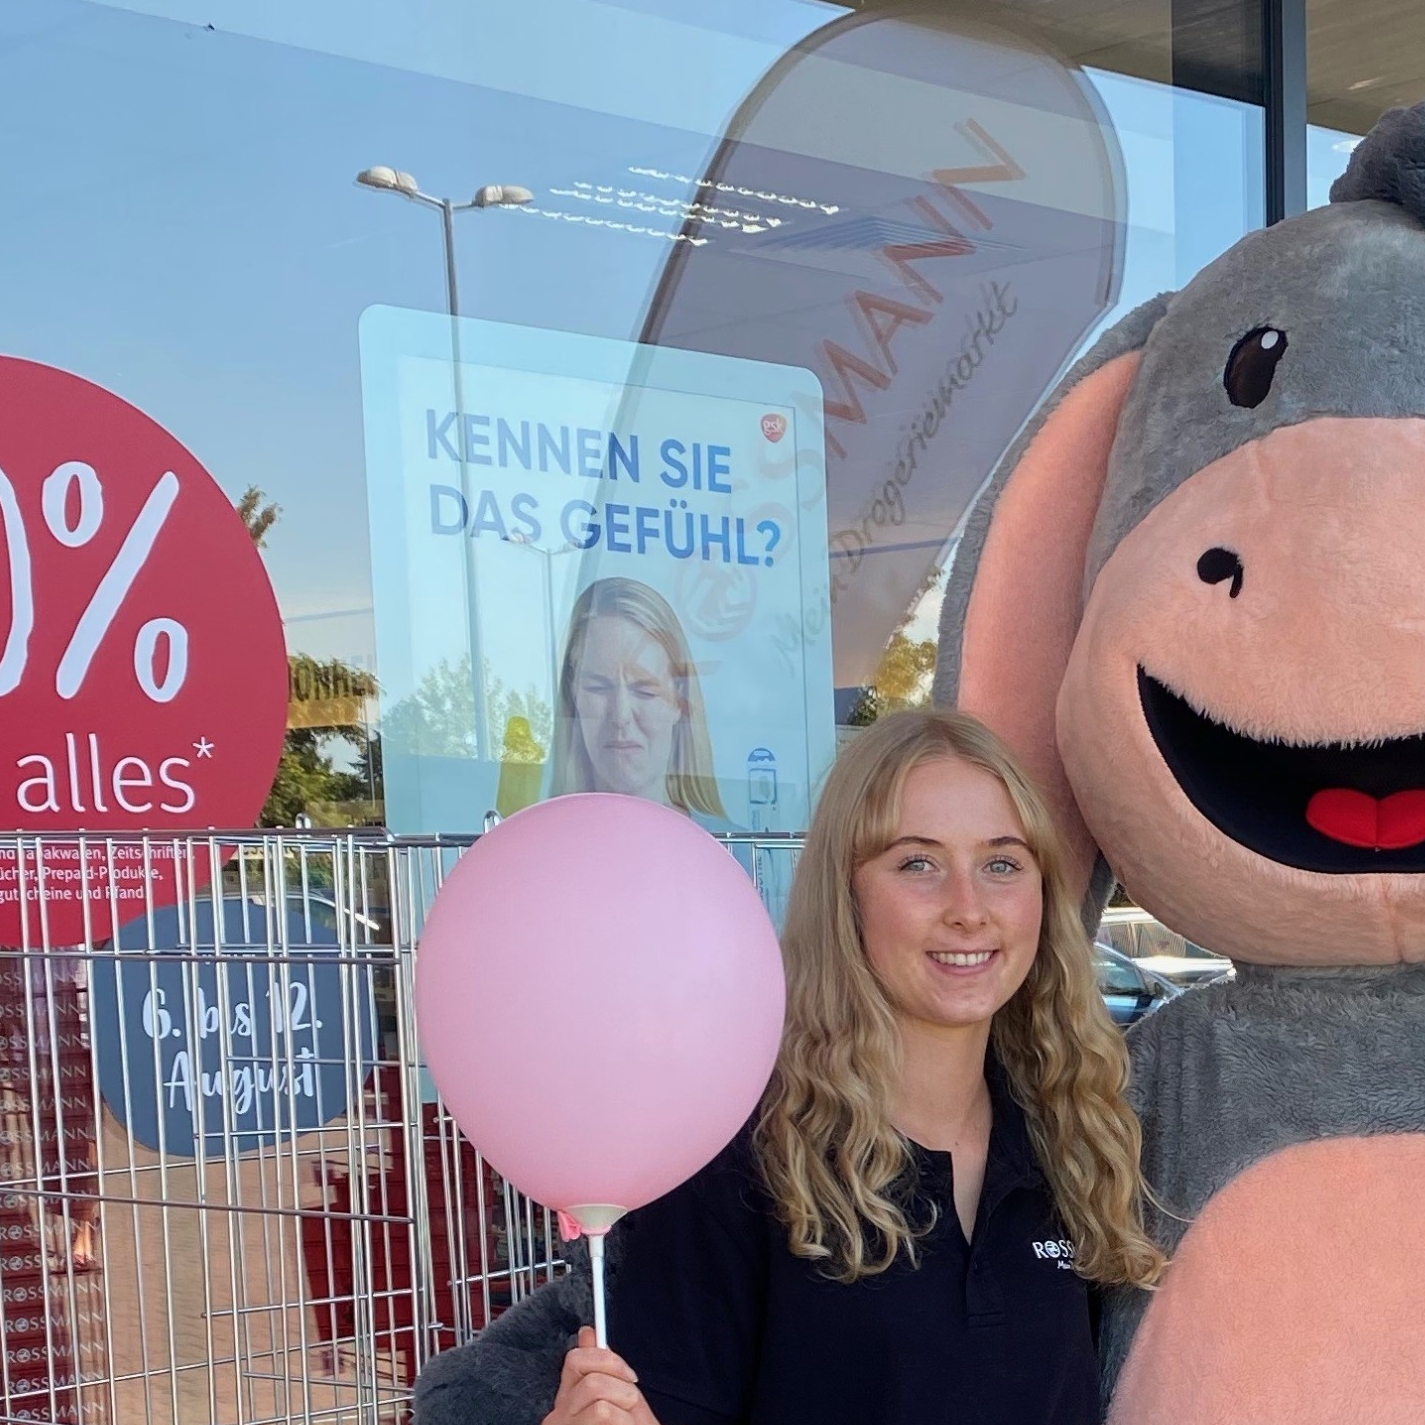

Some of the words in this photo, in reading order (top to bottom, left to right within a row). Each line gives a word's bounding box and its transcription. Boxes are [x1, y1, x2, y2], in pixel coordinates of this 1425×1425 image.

[425, 408, 641, 484] KENNEN
[660, 438, 733, 494] SIE
[429, 483, 542, 543] DAS
[560, 498, 782, 568] GEFÜHL?
[142, 988, 182, 1040] 6.
[163, 1046, 316, 1115] August
